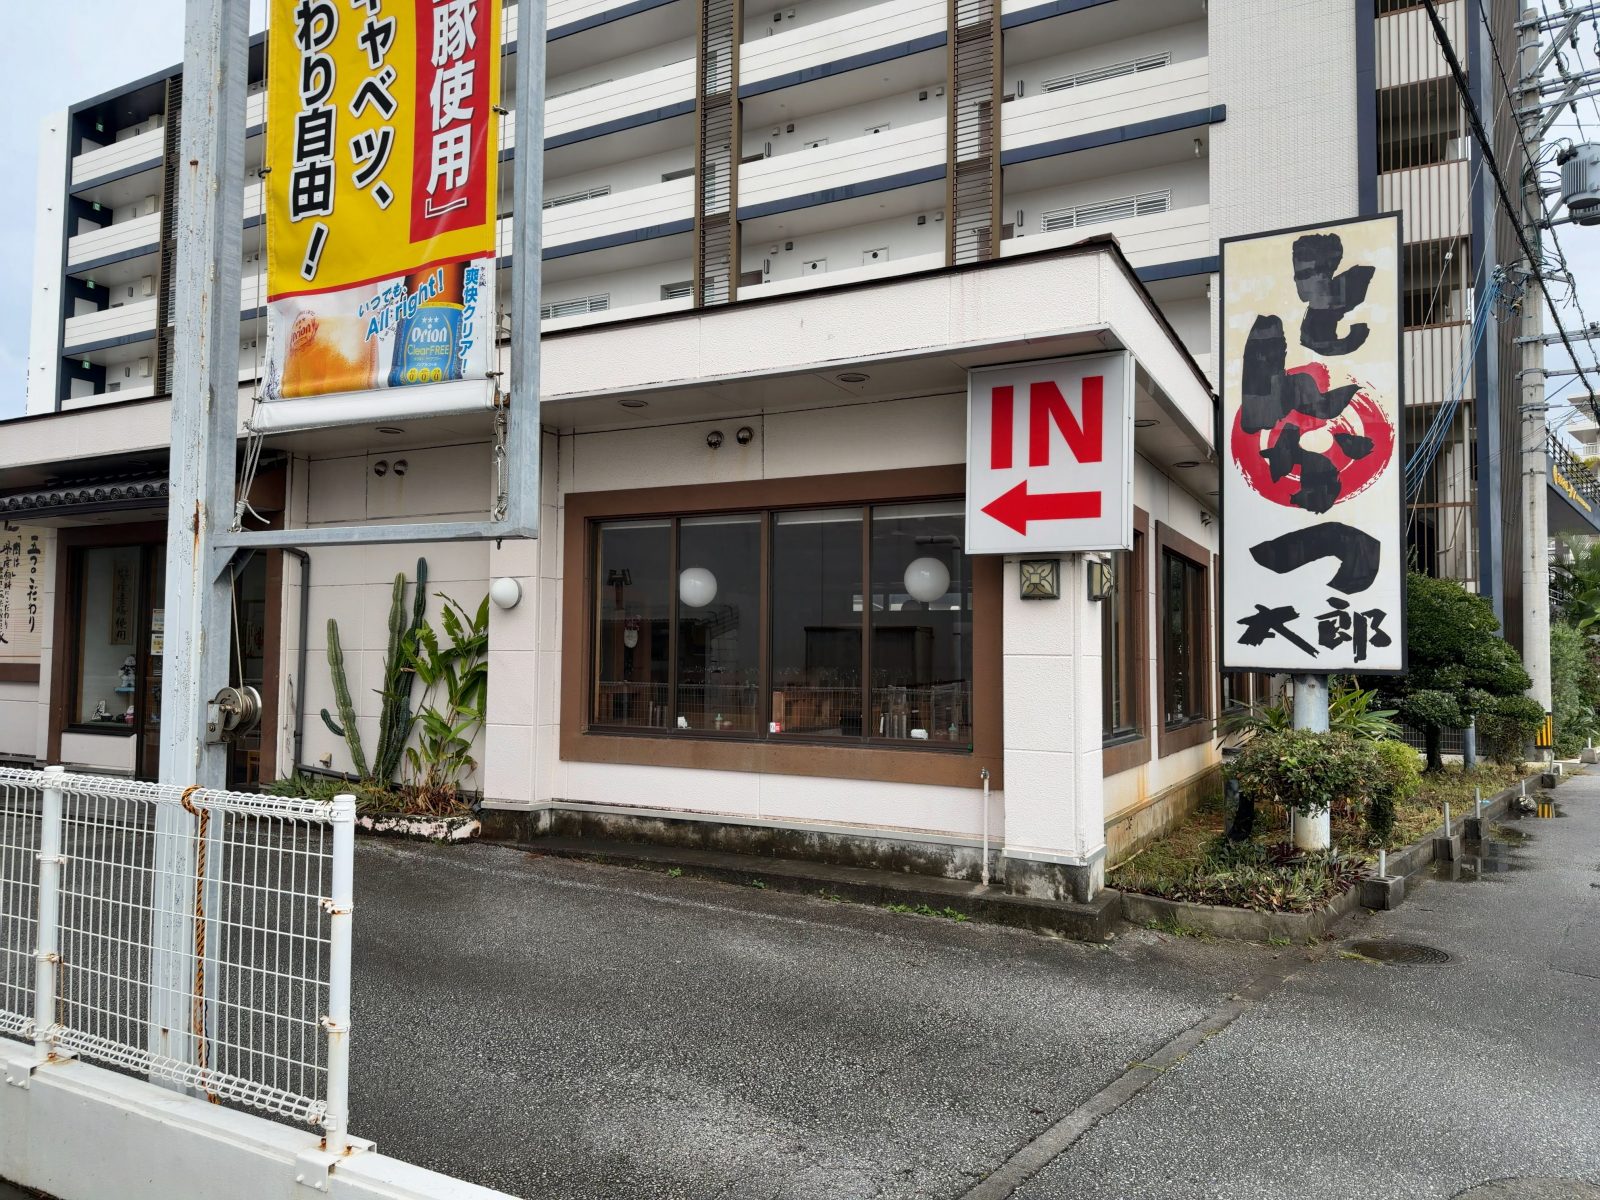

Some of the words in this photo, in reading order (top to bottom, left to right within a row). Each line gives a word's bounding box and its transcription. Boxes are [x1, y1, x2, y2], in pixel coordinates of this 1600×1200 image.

[425, 0, 477, 219] 豚使用』
[365, 308, 390, 342] All
[395, 268, 445, 322] right!
[412, 324, 448, 342] Orion
[991, 376, 1103, 470] IN
[1241, 233, 1382, 594] とんかつ
[1237, 597, 1392, 663] 太郎
